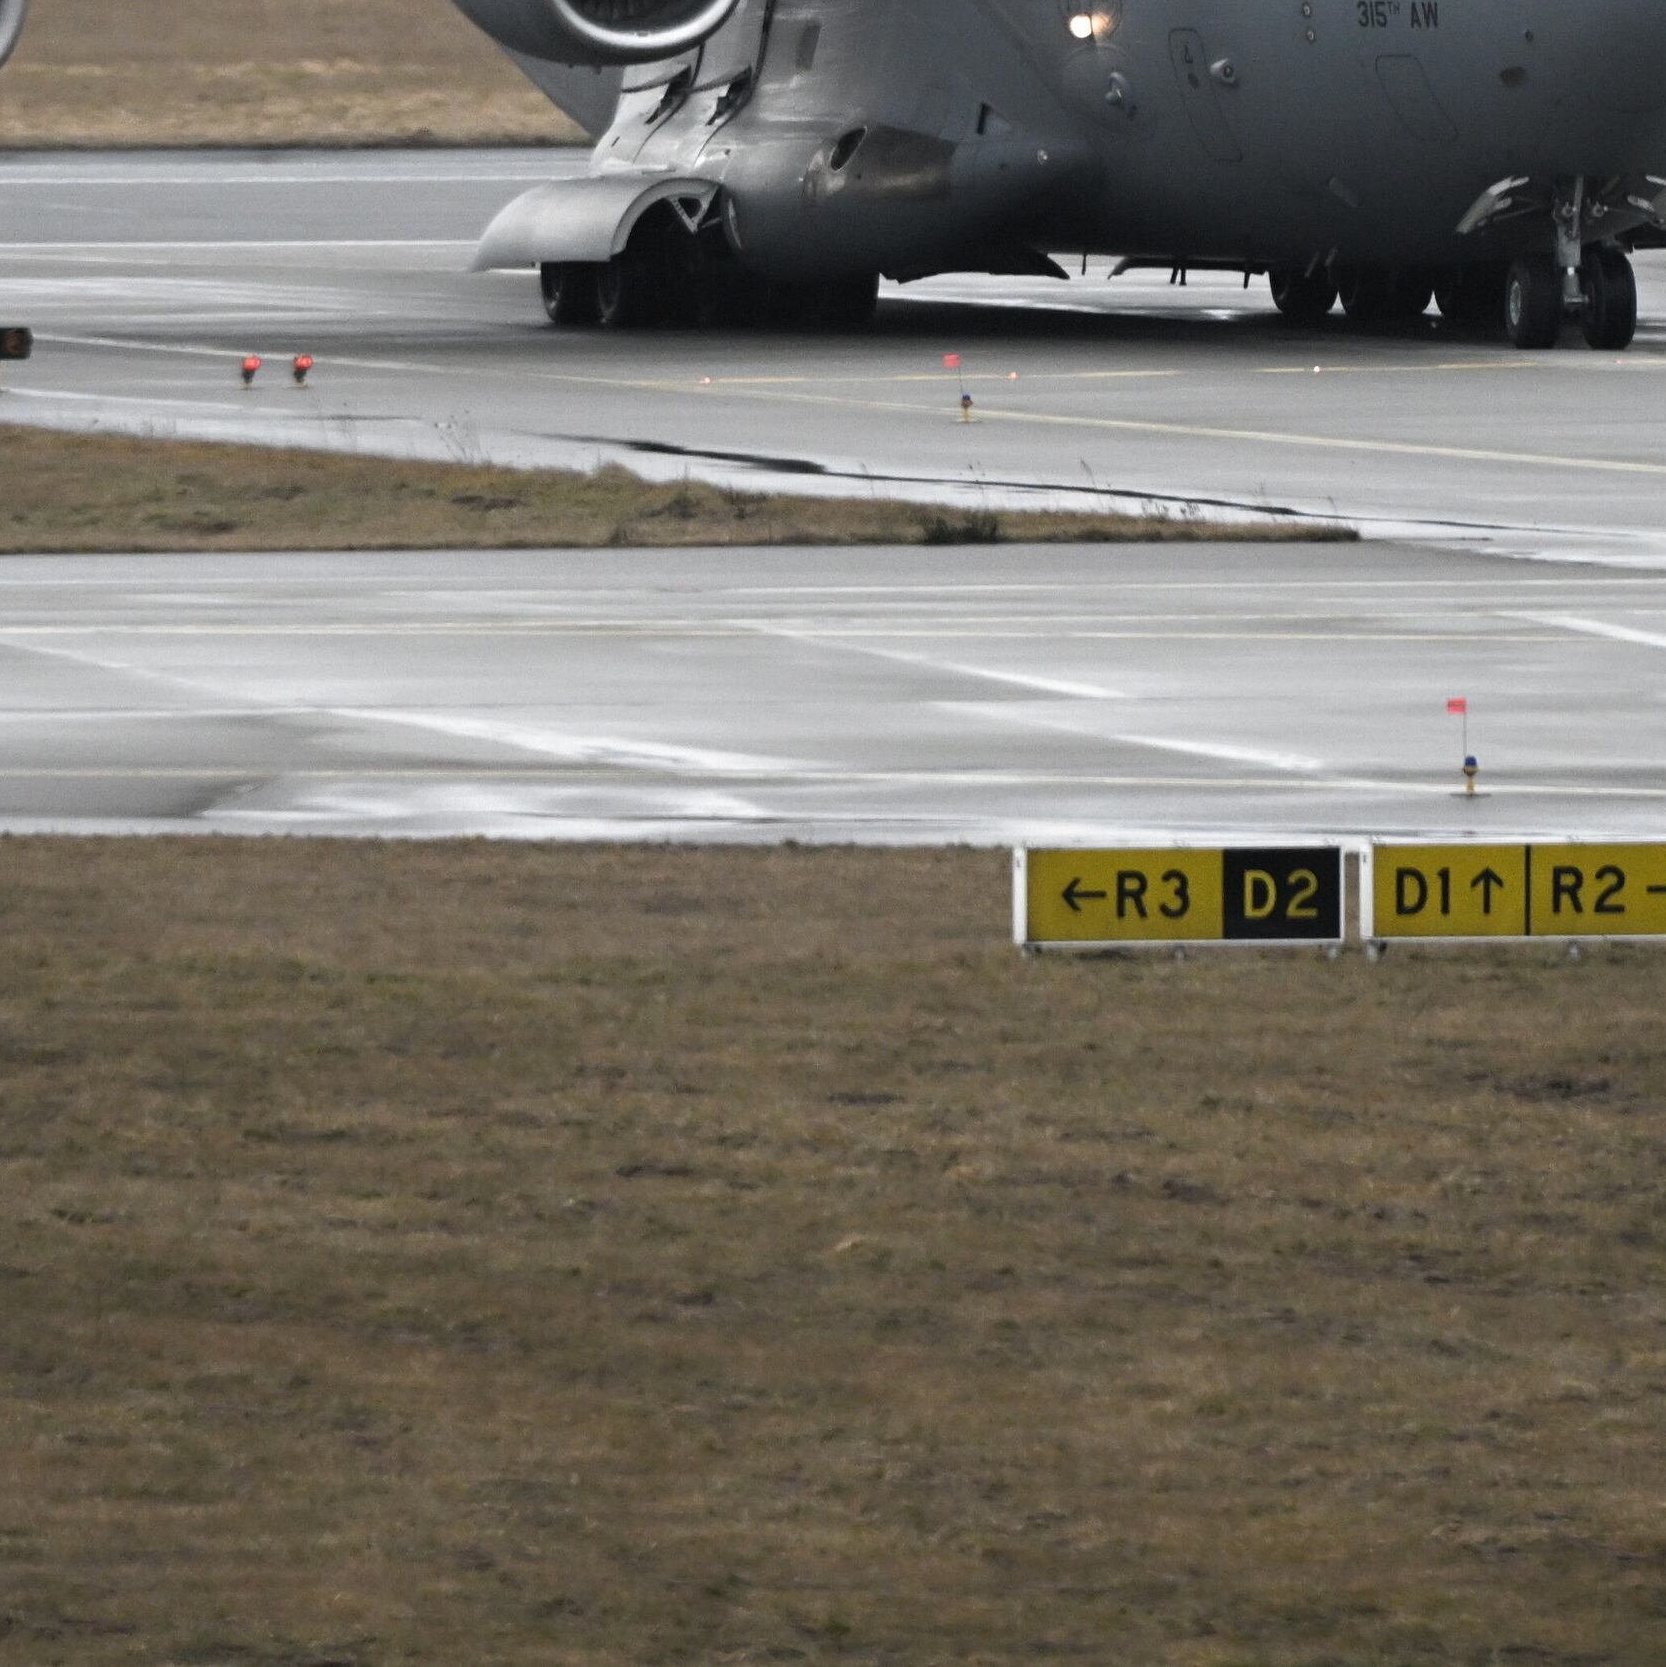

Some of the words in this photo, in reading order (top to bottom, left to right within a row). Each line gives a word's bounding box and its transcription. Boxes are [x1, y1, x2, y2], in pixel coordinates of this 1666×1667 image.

[1410, 1, 1439, 28] AW
[1116, 869, 1190, 918] R3
[1243, 869, 1319, 918] D2
[1395, 867, 1451, 915] D1
[1553, 866, 1626, 913] R2
